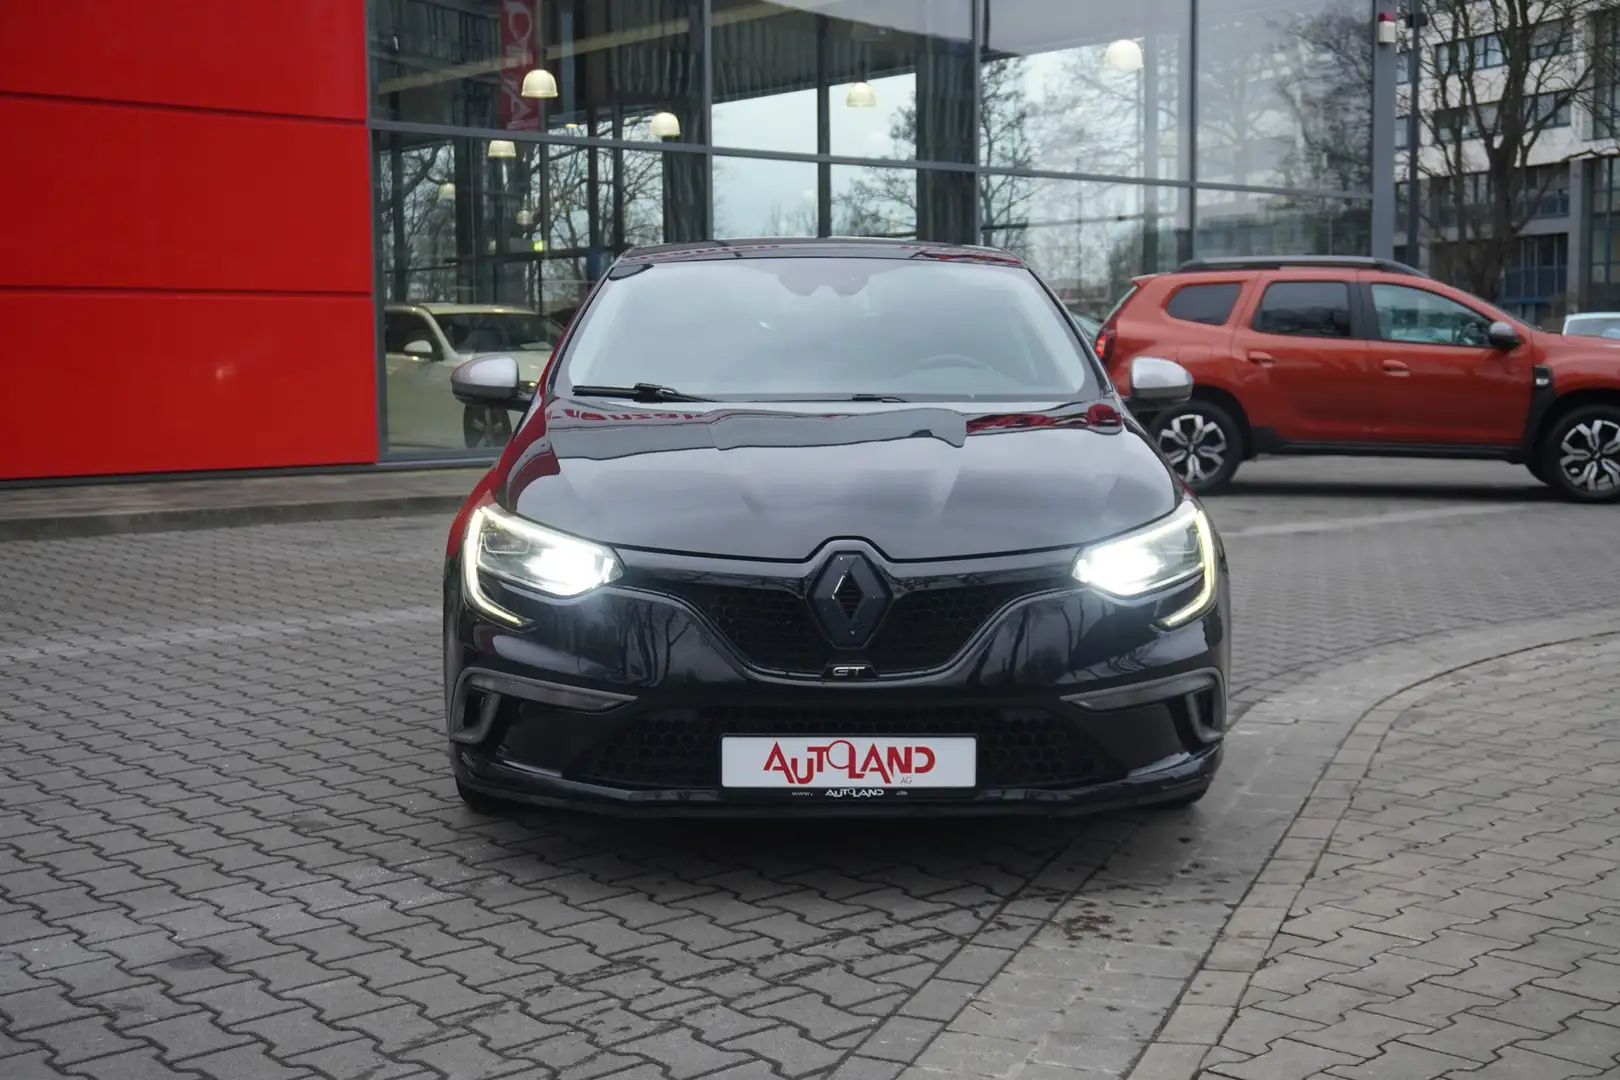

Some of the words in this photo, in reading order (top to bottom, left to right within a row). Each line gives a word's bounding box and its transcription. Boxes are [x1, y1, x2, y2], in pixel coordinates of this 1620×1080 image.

[833, 666, 866, 677] GT
[763, 740, 936, 785] AUTOLAND
[900, 777, 913, 785] AG
[825, 788, 884, 798] AUTOLAND
